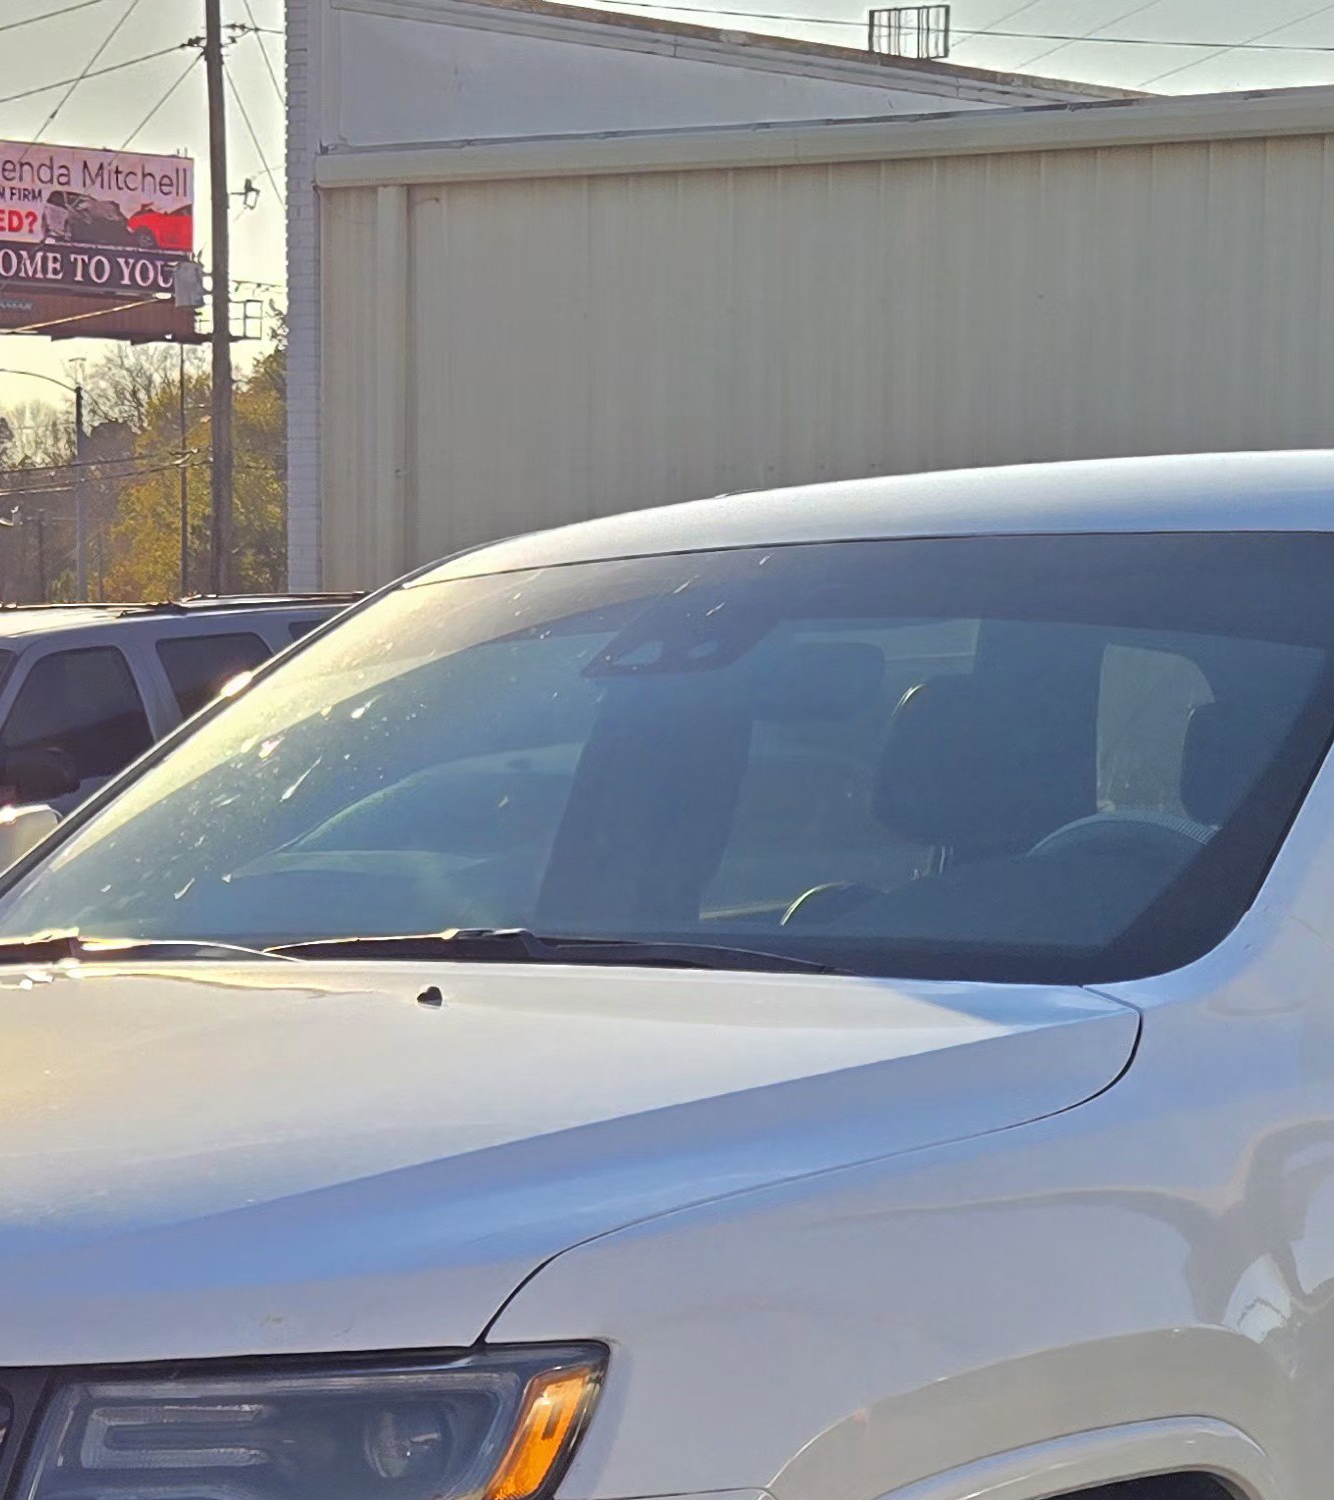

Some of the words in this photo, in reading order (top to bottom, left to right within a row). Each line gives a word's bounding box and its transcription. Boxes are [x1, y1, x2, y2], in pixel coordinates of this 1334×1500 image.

[9, 186, 44, 202] FIRM
[82, 160, 187, 197] Mitchell
[70, 254, 111, 283] TO
[117, 257, 178, 288] YOU
